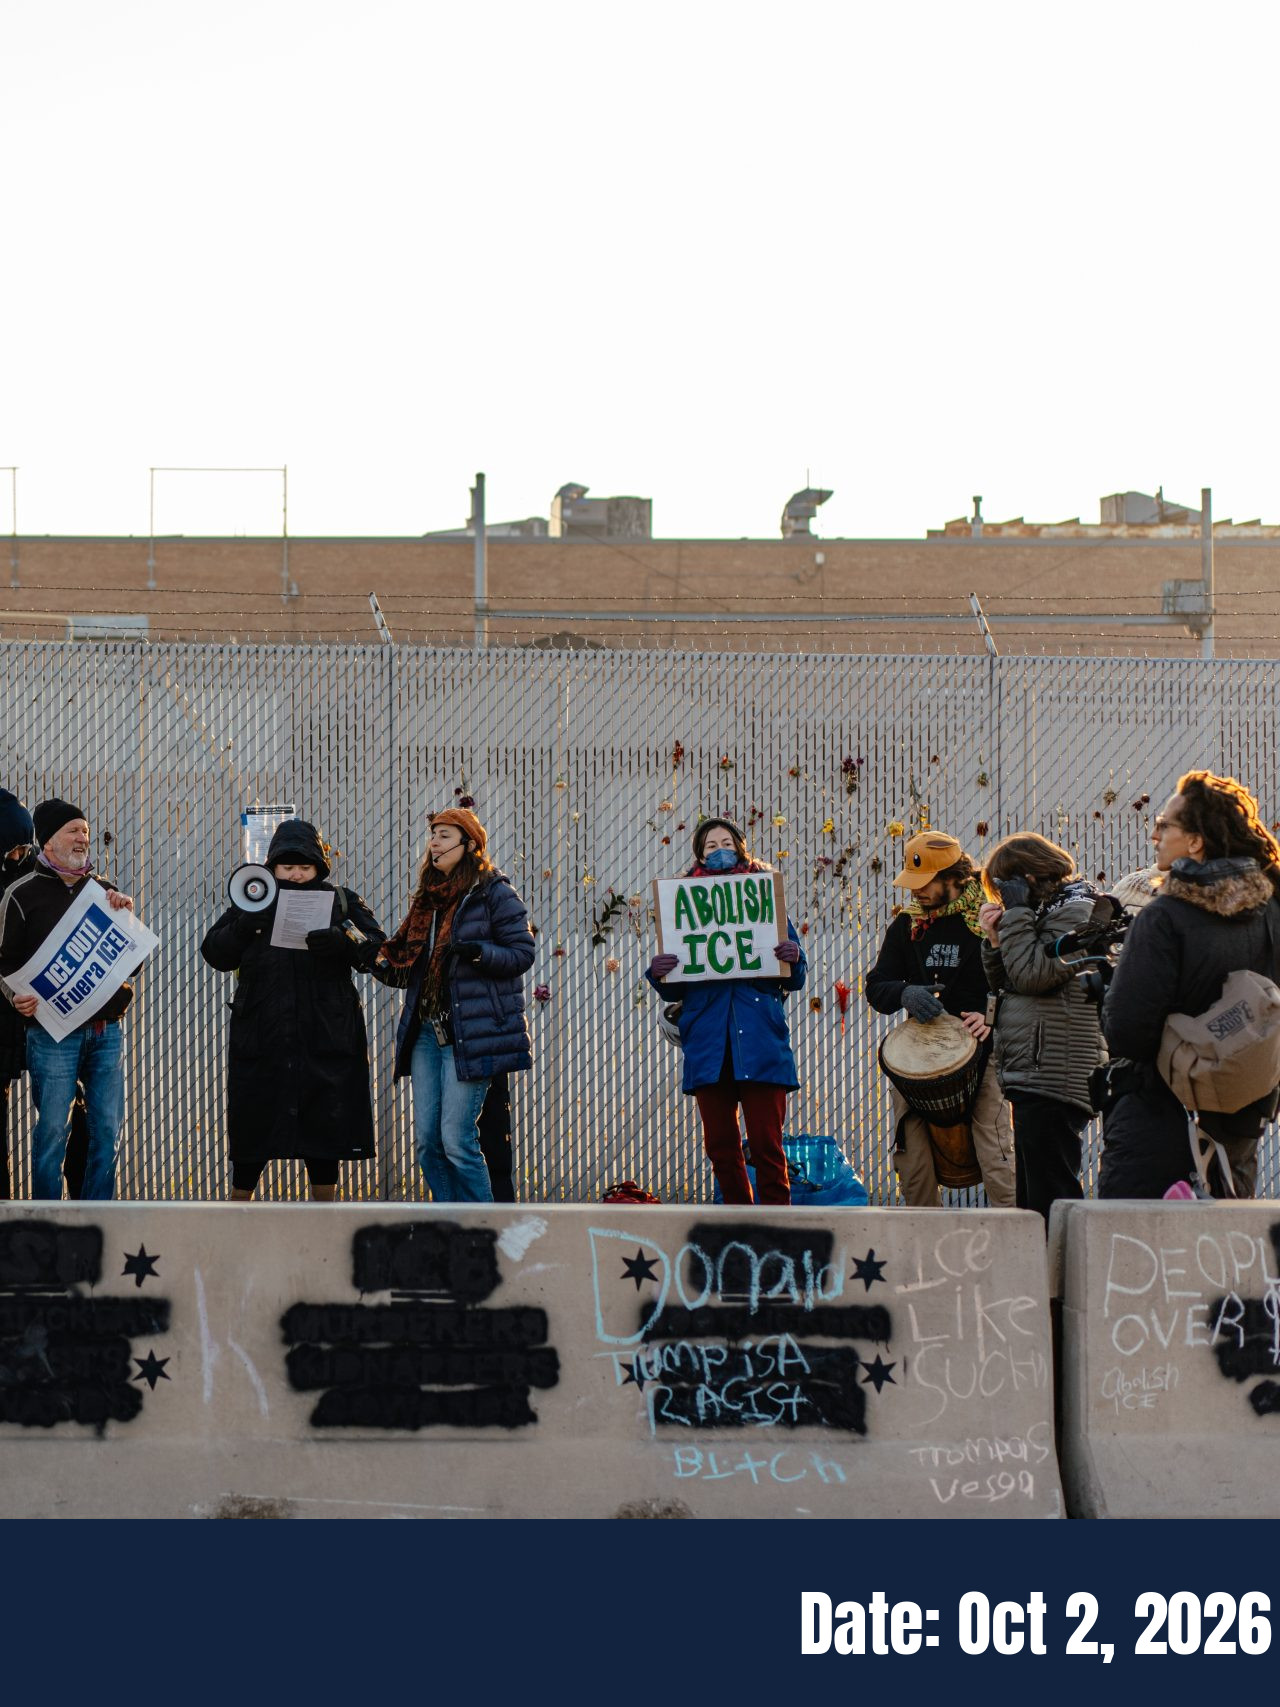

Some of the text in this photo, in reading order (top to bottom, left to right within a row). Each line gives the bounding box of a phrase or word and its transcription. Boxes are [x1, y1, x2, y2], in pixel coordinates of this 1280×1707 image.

[675, 878, 774, 930] ABOLISH
[43, 917, 103, 990] ICE OUT!
[95, 927, 130, 967] ICE!
[682, 930, 762, 975] ICE
[1111, 1290, 1246, 1356] OVER
